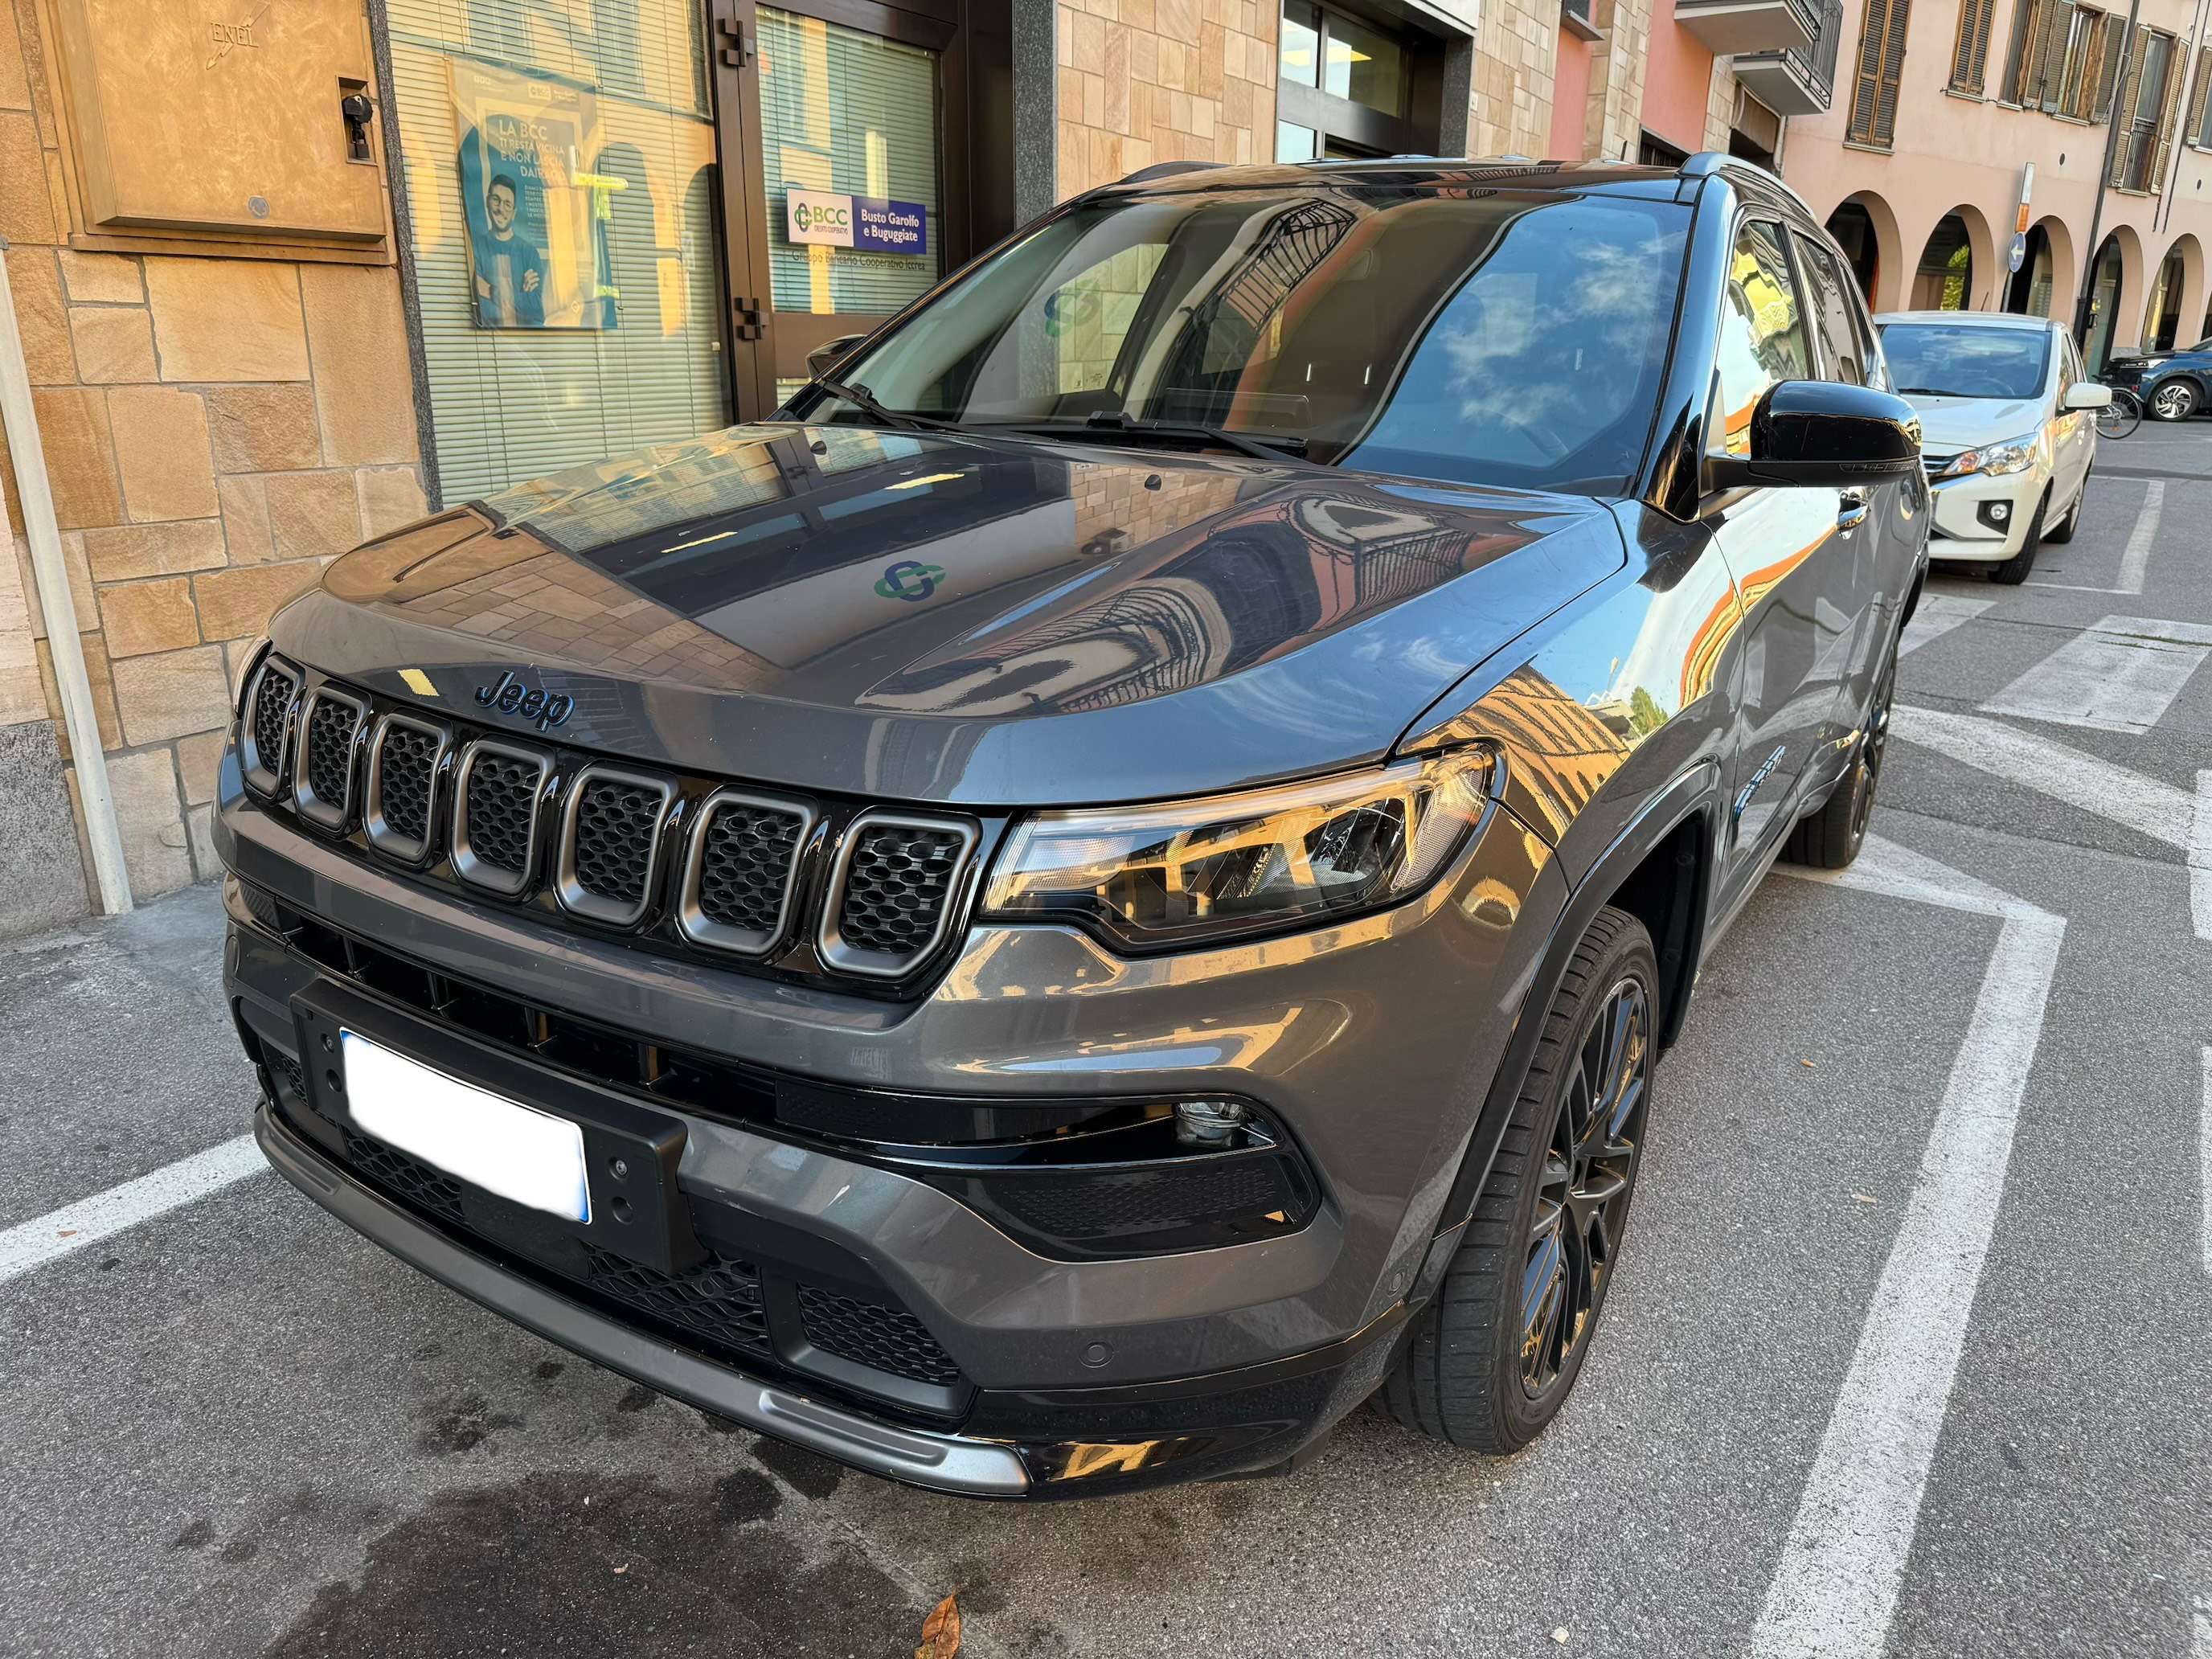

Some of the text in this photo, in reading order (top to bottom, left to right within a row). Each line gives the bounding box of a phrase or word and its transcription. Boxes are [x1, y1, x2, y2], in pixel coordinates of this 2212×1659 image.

[209, 20, 259, 49] ENEL
[498, 119, 547, 141] LA BCC
[501, 150, 507, 162] E
[509, 152, 530, 164] NON
[509, 139, 535, 151] RESTA
[535, 141, 566, 155] VICINA
[813, 206, 849, 226] BCC
[861, 208, 920, 227] Busto Garolfo
[863, 224, 918, 244] e Buguggiate
[792, 250, 926, 271] Gruppo Bancario Cooperativo Iccrea
[474, 670, 576, 733] Jeep
